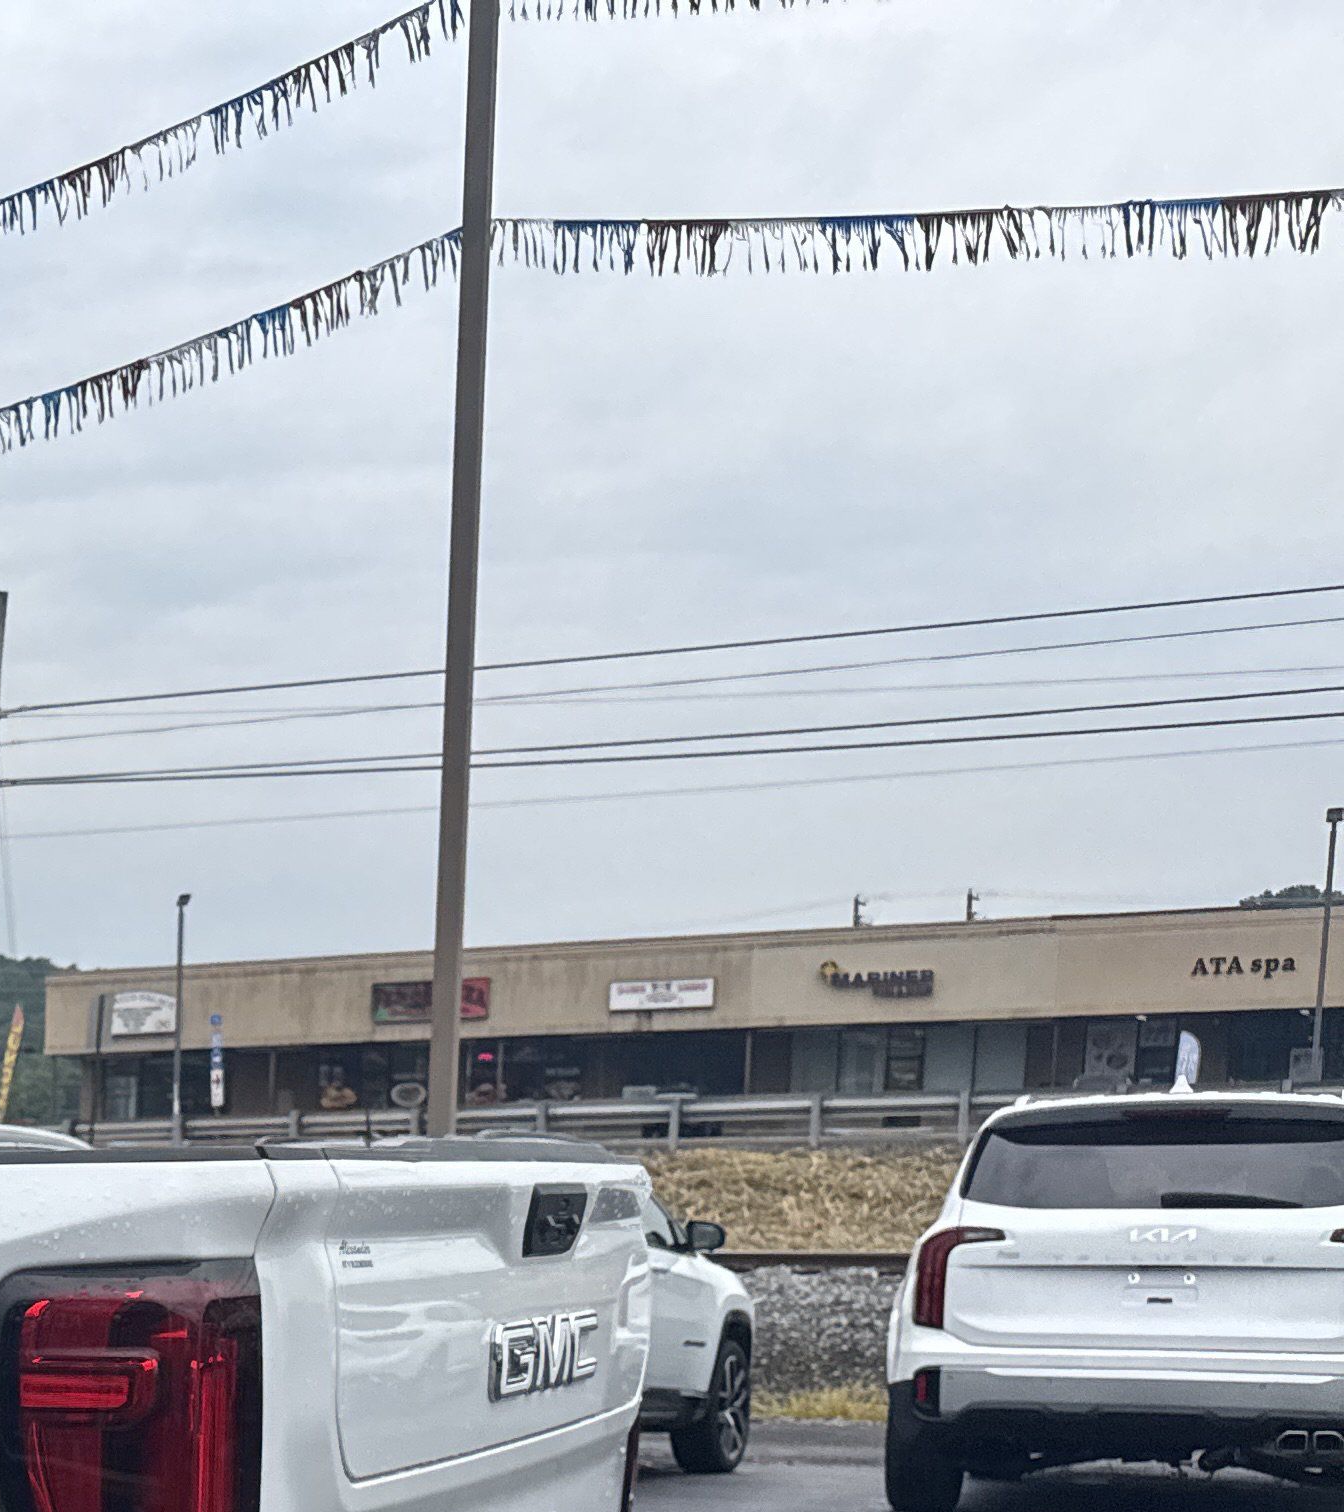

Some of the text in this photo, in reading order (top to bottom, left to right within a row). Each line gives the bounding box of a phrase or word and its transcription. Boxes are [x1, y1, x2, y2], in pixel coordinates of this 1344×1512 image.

[1191, 956, 1296, 979] ATA spa
[831, 969, 934, 988] MARINER
[1129, 1228, 1198, 1243] KIA
[488, 1309, 598, 1402] GMC
